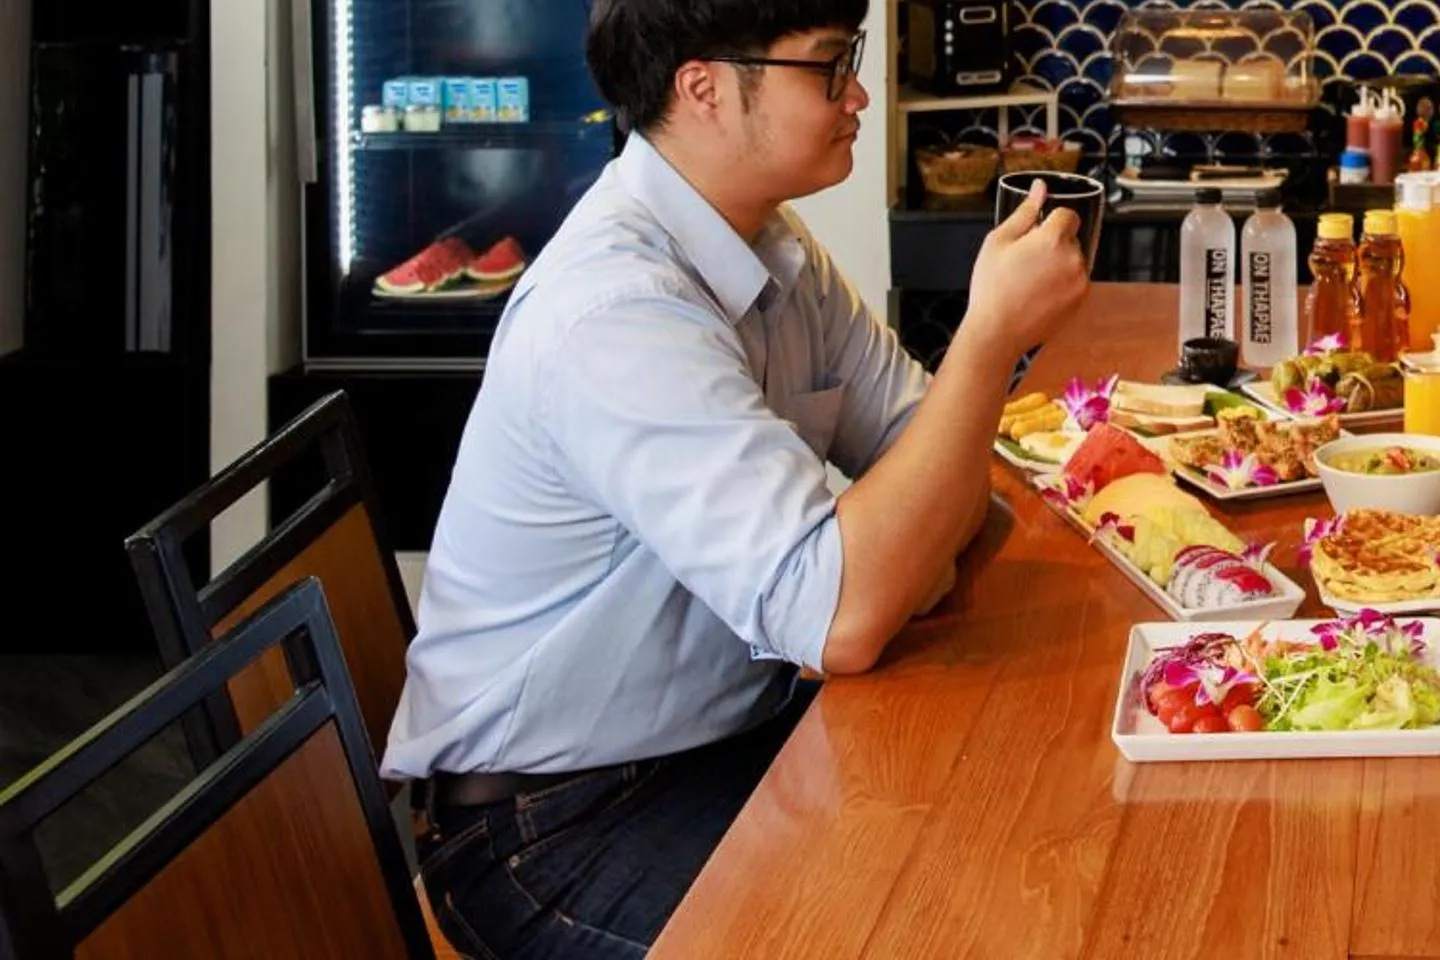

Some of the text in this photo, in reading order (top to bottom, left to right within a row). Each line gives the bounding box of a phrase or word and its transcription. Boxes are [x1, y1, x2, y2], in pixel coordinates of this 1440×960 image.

[1212, 250, 1226, 274] ON
[1253, 253, 1271, 344] ON THAPAE
